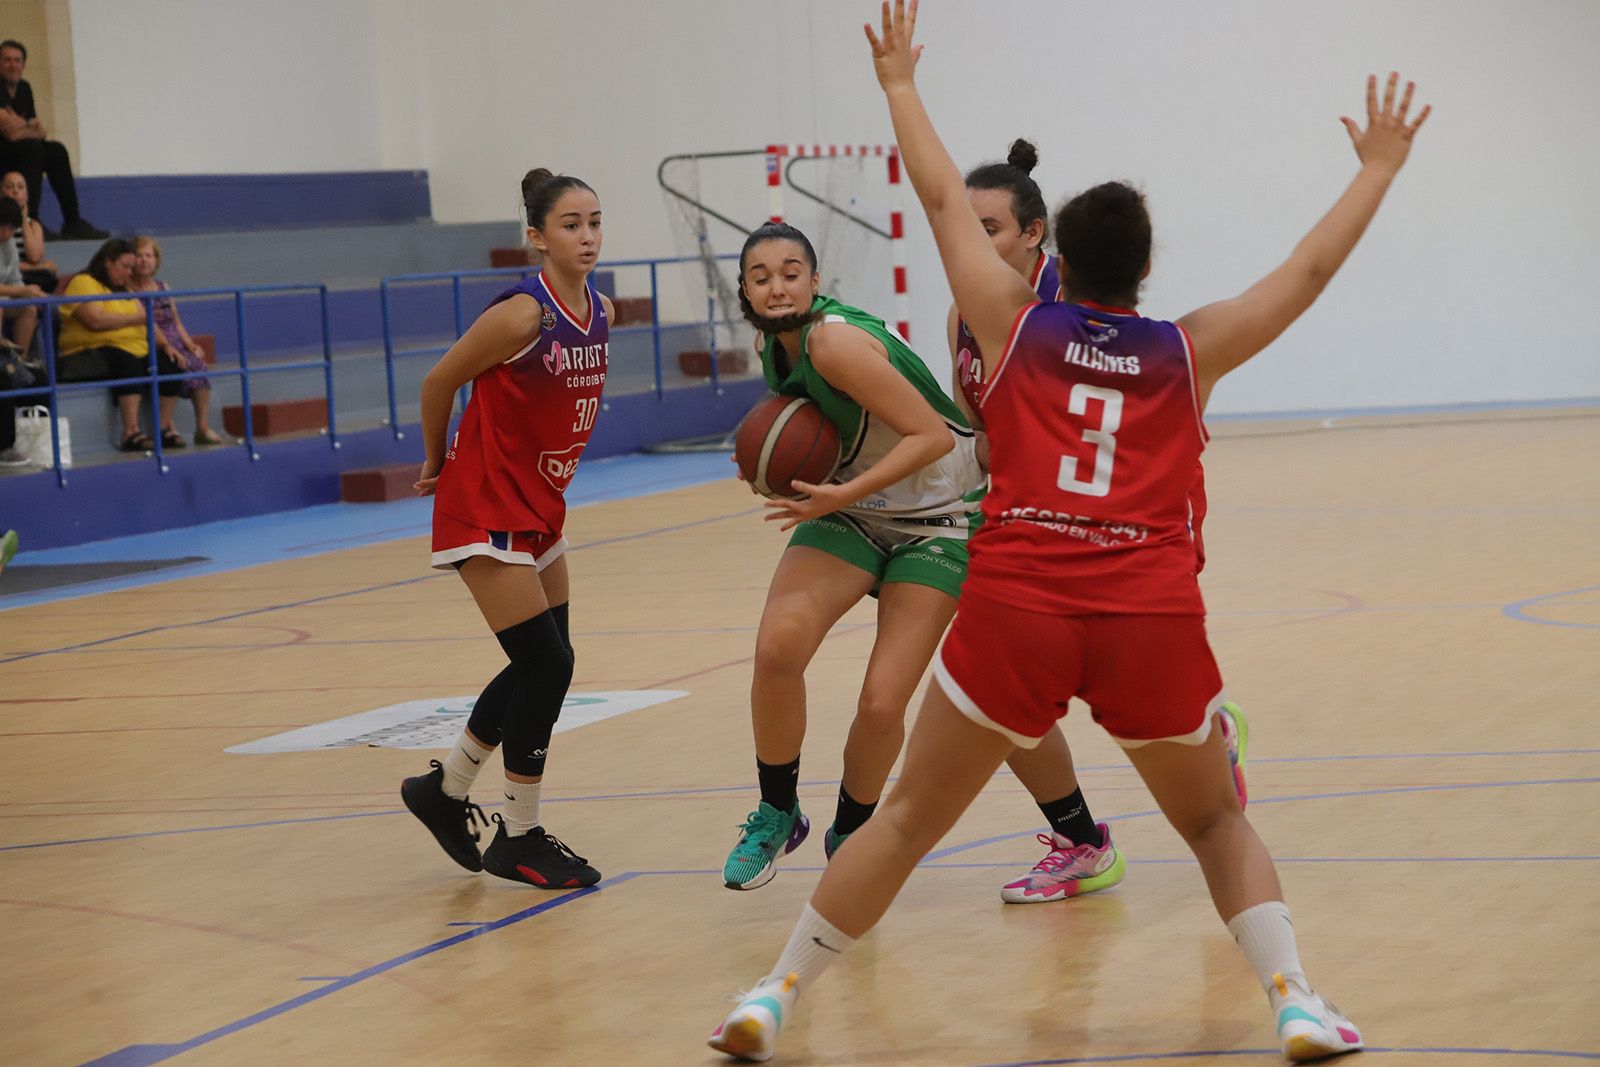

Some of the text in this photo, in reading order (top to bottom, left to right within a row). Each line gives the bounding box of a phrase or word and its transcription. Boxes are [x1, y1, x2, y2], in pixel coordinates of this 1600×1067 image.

[1064, 341, 1140, 375] ILLANES
[573, 397, 598, 433] 30
[1056, 383, 1124, 497] 3
[940, 559, 962, 574] CALOR
